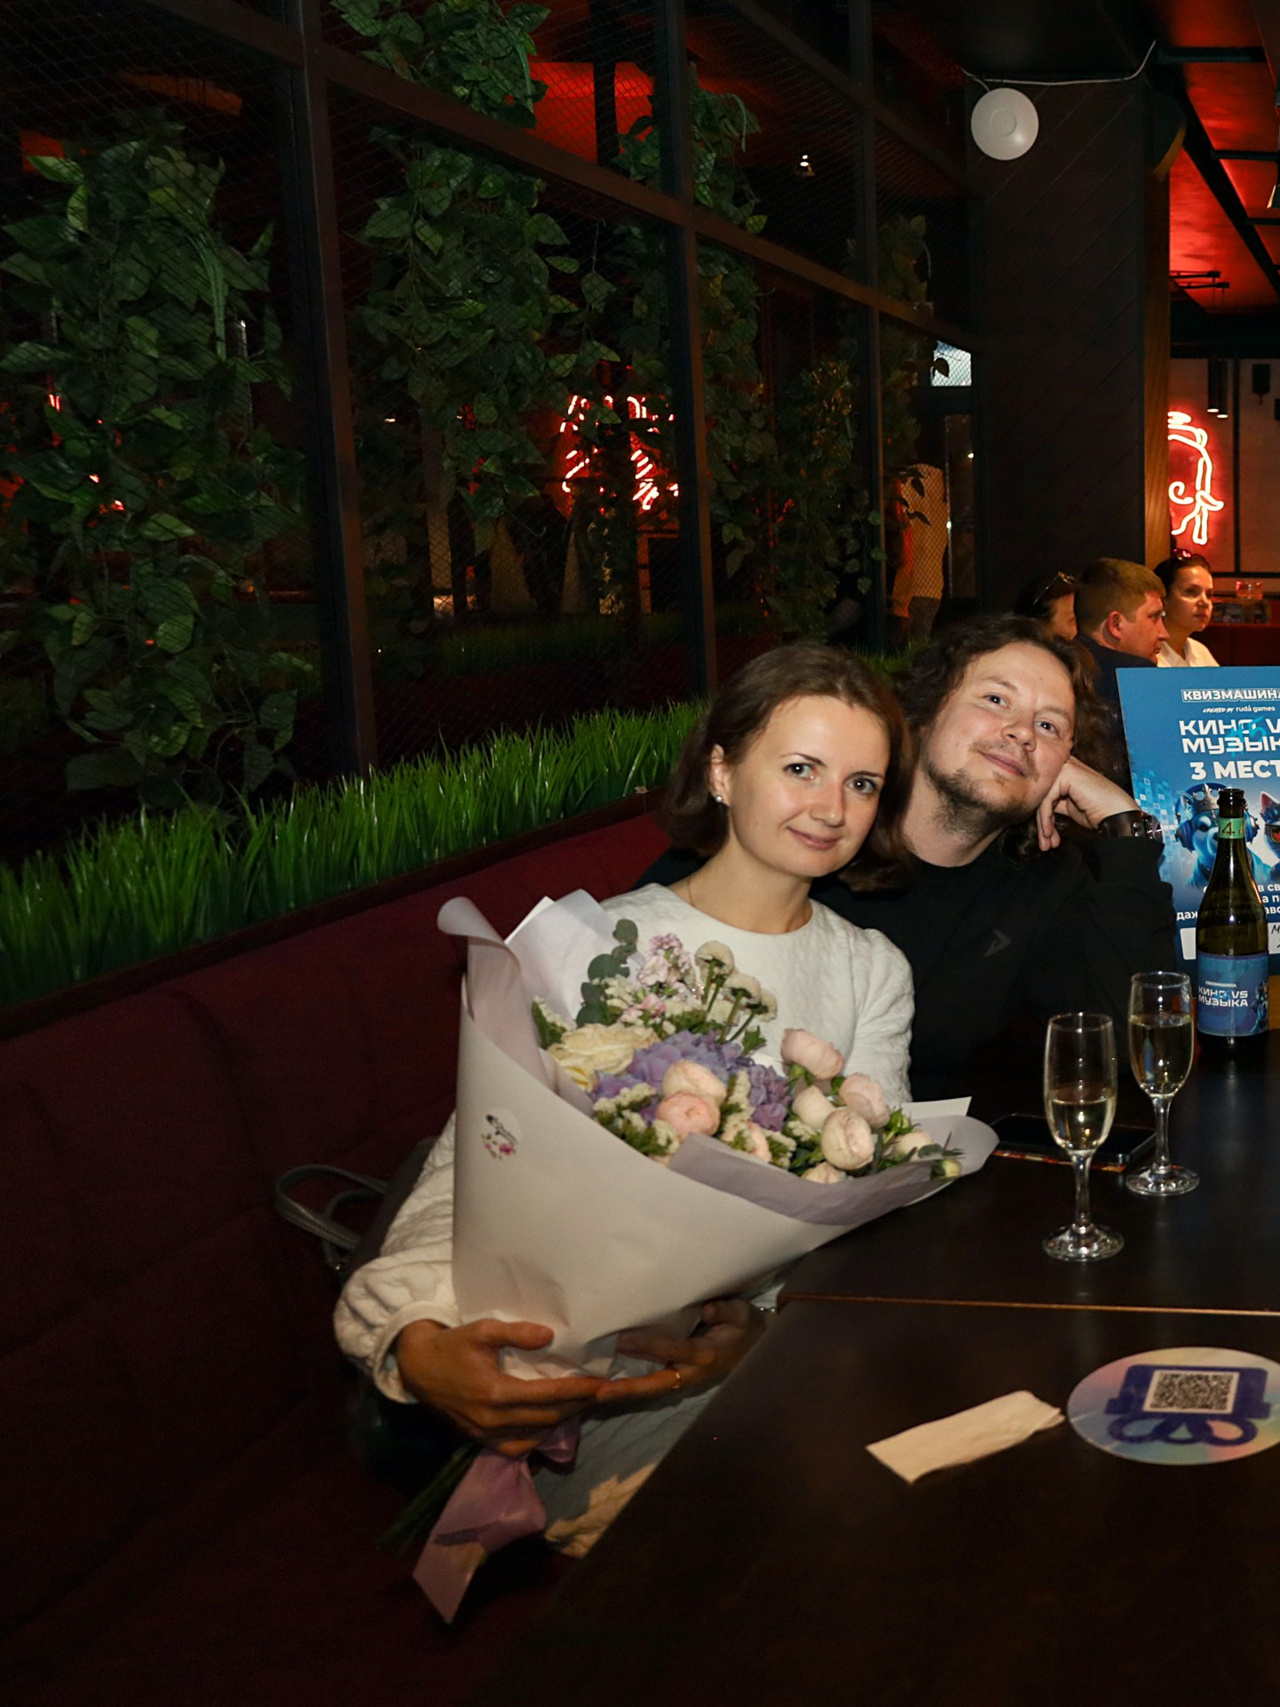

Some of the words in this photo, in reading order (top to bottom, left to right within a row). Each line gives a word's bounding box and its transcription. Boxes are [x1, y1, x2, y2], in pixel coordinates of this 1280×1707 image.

[1179, 718, 1257, 736] КИНО
[1189, 761, 1207, 781] 3
[1199, 994, 1249, 1007] МУЗЫКА
[1231, 990, 1249, 999] VS
